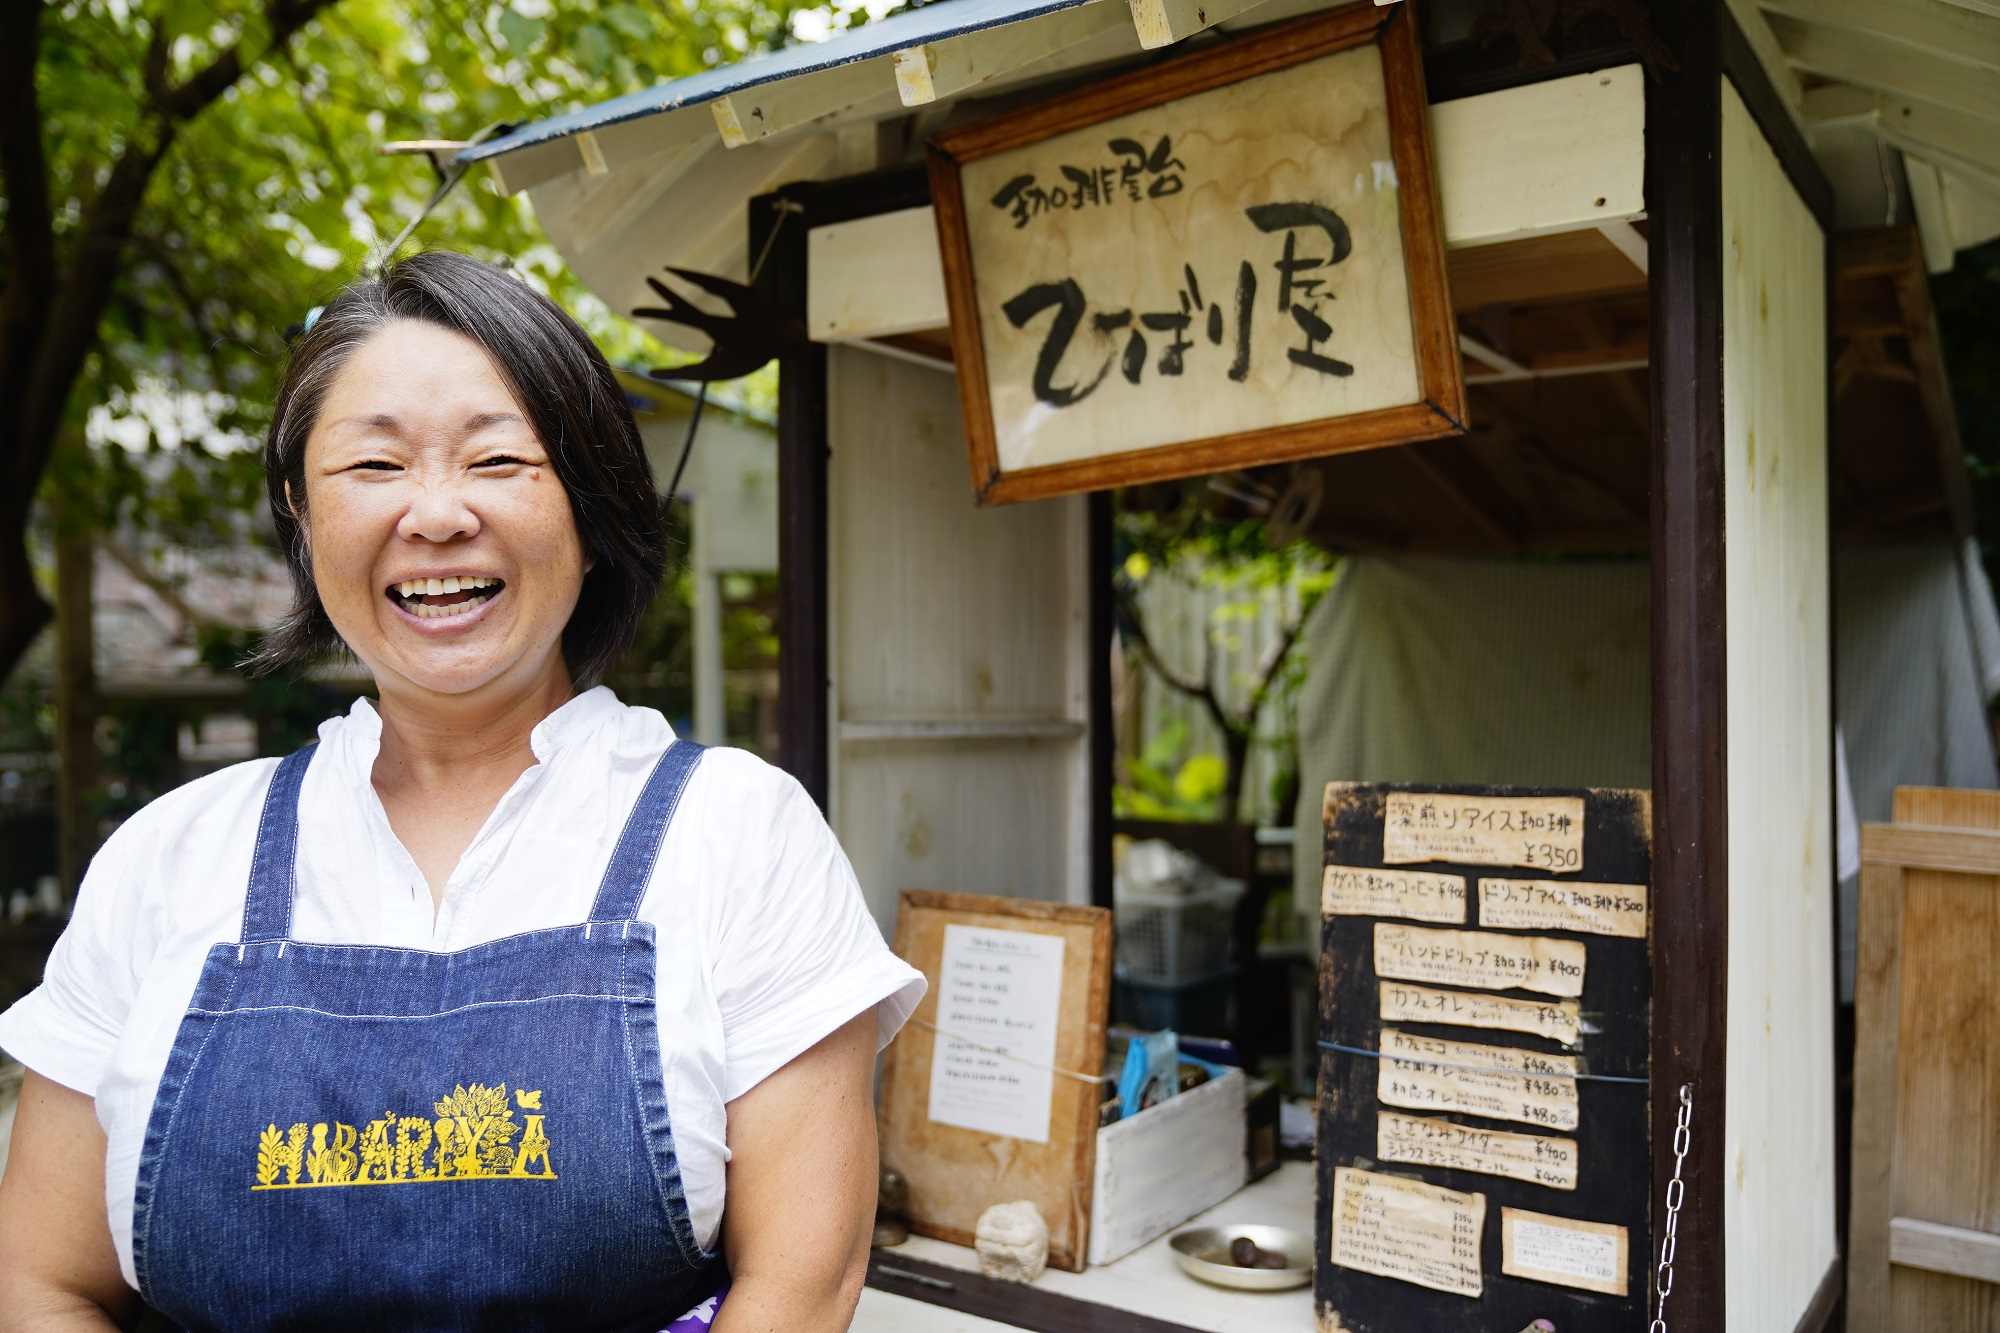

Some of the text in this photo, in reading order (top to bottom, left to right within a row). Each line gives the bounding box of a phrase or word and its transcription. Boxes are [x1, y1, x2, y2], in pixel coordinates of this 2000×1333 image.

[990, 134, 1186, 229] 珈琲屋台
[1002, 201, 1354, 408] ひばり屋
[1524, 841, 1578, 868] ¥350
[1391, 988, 1463, 1013] カフェオレ
